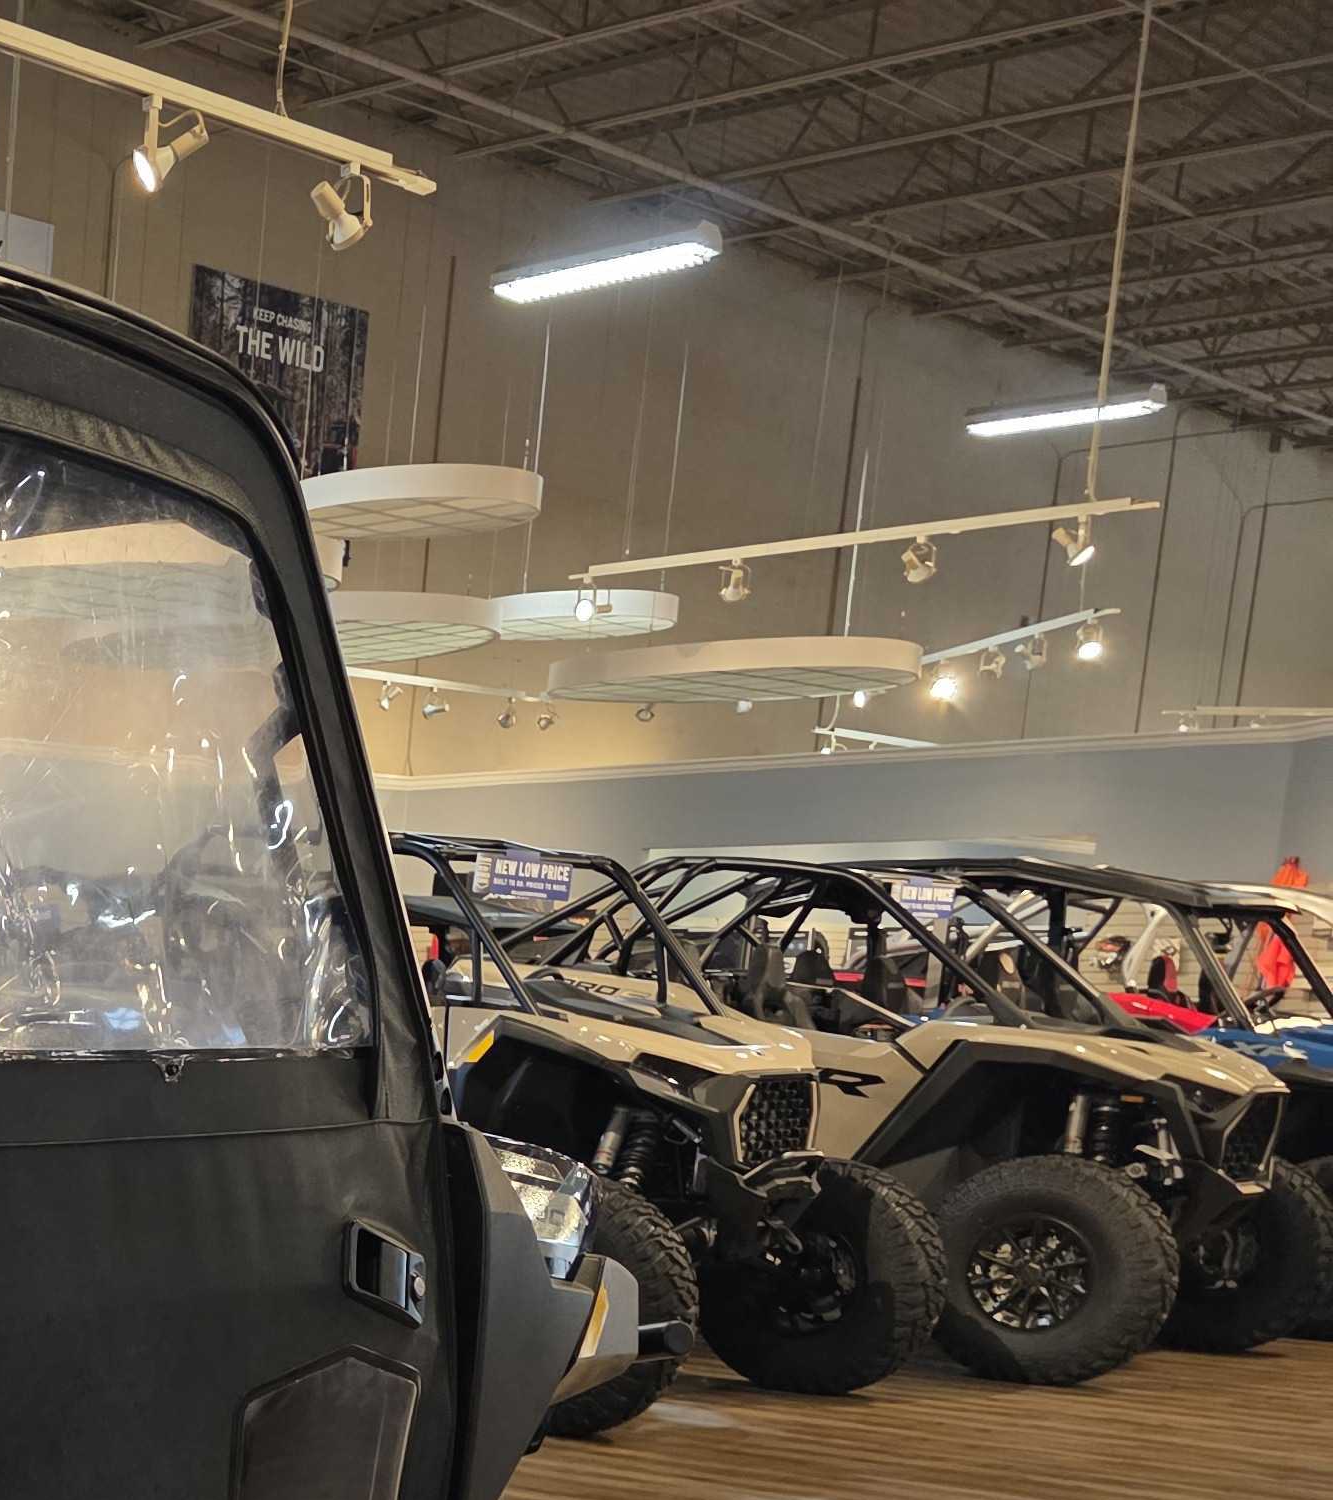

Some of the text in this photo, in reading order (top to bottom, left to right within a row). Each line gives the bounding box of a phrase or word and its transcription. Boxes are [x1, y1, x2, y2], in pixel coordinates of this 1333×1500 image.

[253, 306, 312, 334] KEEP CHASING
[236, 324, 325, 373] THE WILD
[495, 858, 517, 876] NEW
[518, 861, 541, 878] LOW
[541, 864, 571, 882] PRICE
